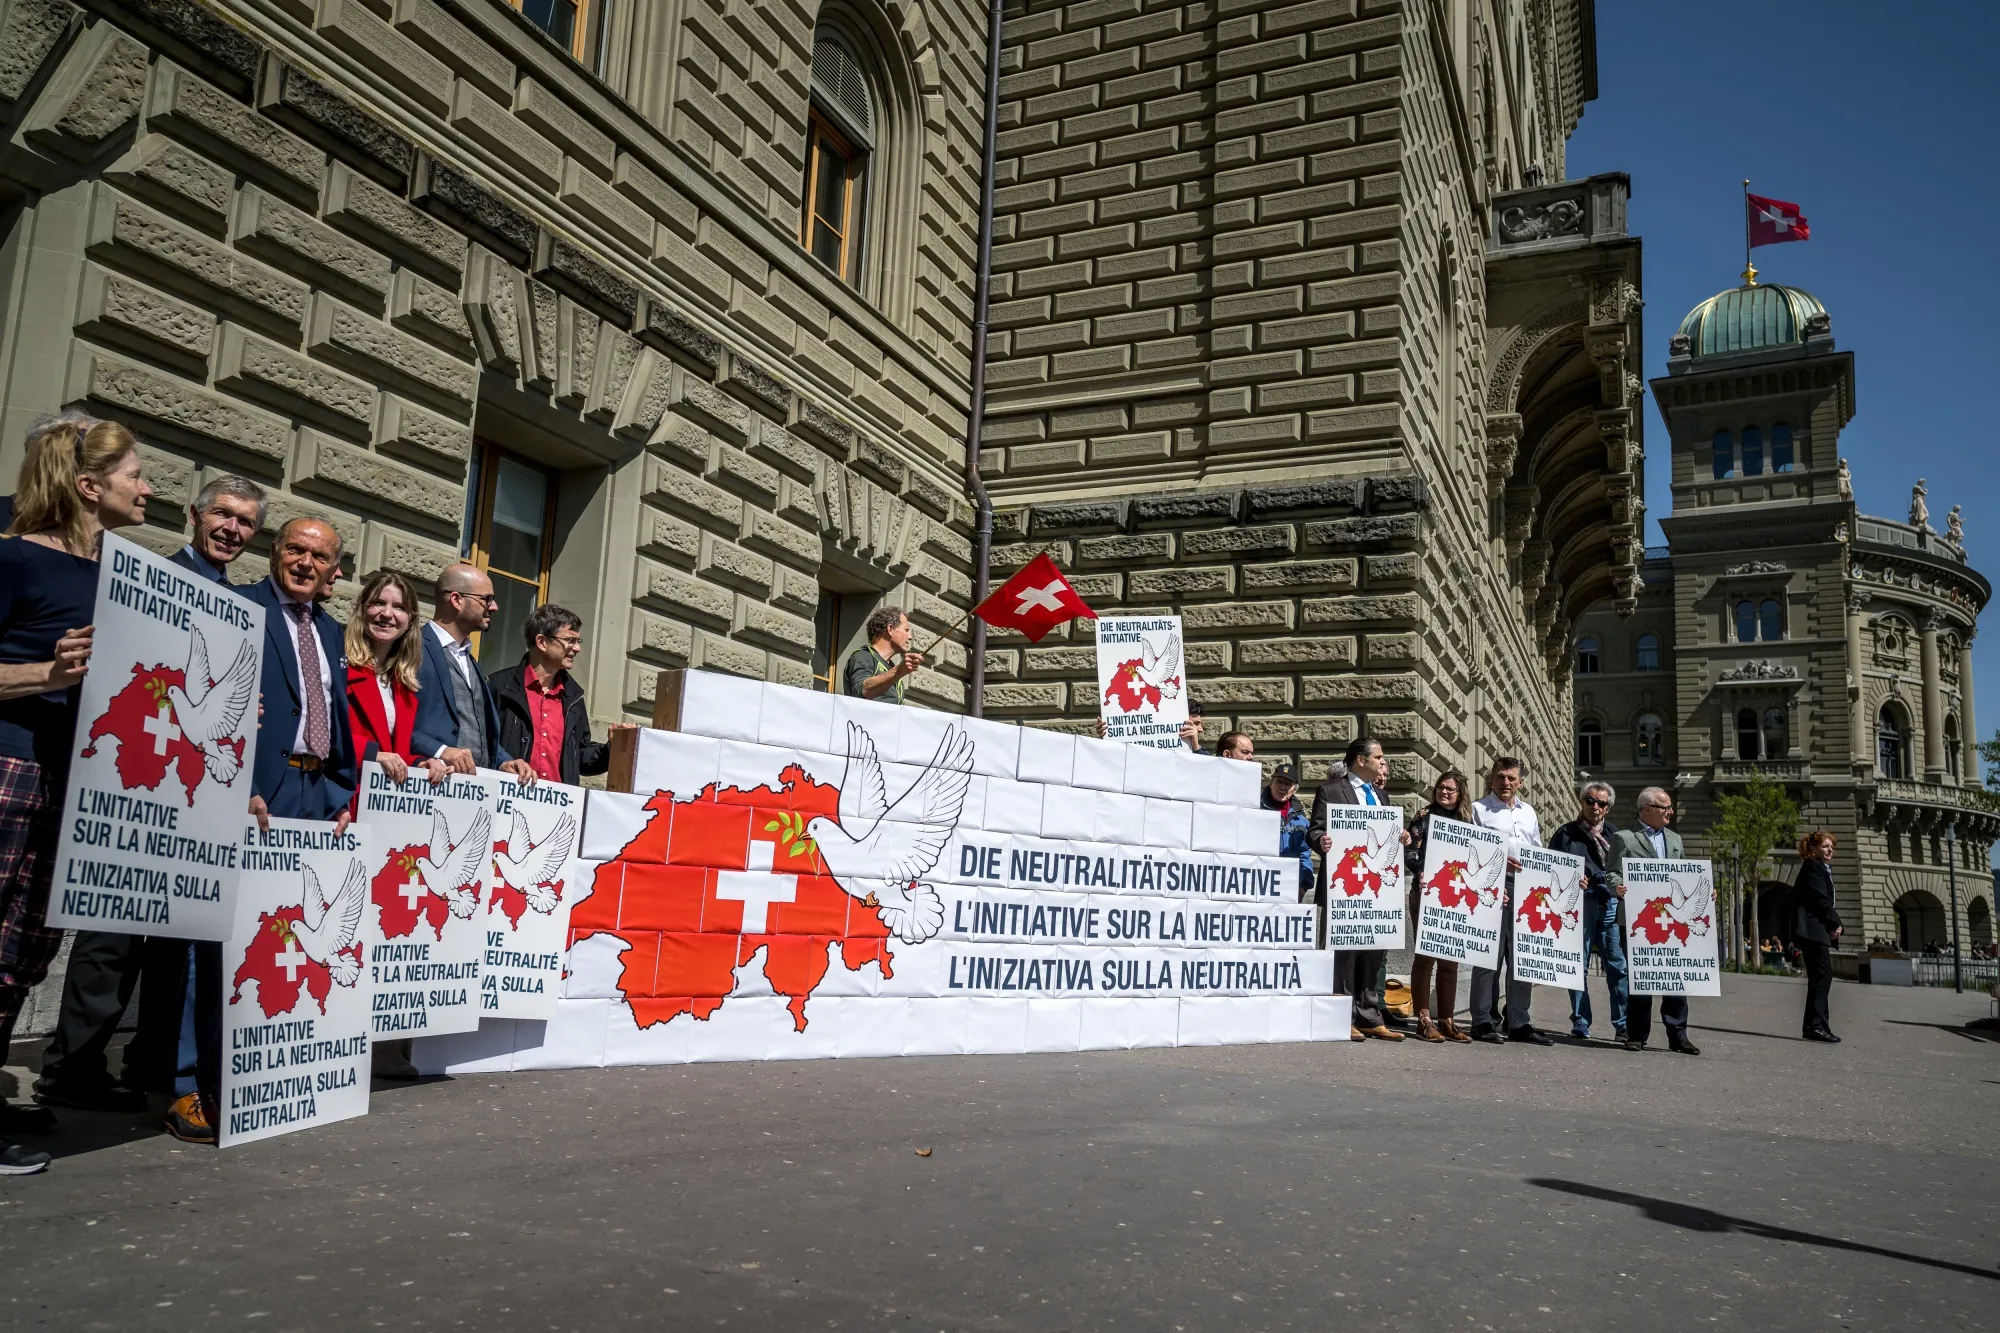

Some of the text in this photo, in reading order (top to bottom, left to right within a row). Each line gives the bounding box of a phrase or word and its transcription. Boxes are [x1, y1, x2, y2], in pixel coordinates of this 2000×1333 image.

[113, 549, 255, 631] DIE NEUTRALITÄTS-
[109, 577, 191, 632] INITIATIVE
[1100, 620, 1175, 632] DIE NEUTRALITÄTS-
[1101, 633, 1141, 643] INITIATIVE
[1107, 714, 1153, 726] L'INITIATIVE
[1108, 723, 1183, 737] SUR LA NEUTRALIT
[1157, 738, 1183, 749] SULLA
[370, 772, 391, 791] DIE
[499, 780, 574, 807] TRALITÄTS-
[78, 787, 179, 830] L'INITIATIVE
[368, 793, 433, 815] INITIATIVE
[1331, 809, 1398, 821] DIE NEUTRALITÄTS-
[1331, 820, 1367, 830] INITIATIVE
[1433, 820, 1503, 845] DIE NEUTRALITÄTS-
[73, 818, 237, 869] SUR LA NEUTRALITÉ
[259, 828, 361, 851] NEUTRALITÄTS-
[1432, 831, 1470, 847] INITIATIVE
[242, 850, 300, 871] NITIATIVE
[1520, 849, 1579, 868] DIE NEUTRALITÄTS-
[1627, 862, 1705, 874] DIE NEUTRALITÄTS-
[67, 858, 220, 902] L'INIZIATIVA SULLA
[959, 844, 1281, 897] DIE NEUTRALITÄTSINITIATIVE
[1628, 873, 1670, 883] INITIATIVE
[61, 889, 169, 924] NEUTRALITÀ
[1331, 899, 1373, 909] L'INITIATIVE
[954, 899, 1312, 943] L'INITIATIVE SUR LA NEUTRALITÉ
[1331, 908, 1402, 920] SUR LA NEUTRALITÉ
[1424, 905, 1467, 923] L'INITIATIVE
[1331, 924, 1397, 935] L'INIZIATIVA SULLA
[1423, 917, 1497, 941] SUR LA NEUTRALITÉ
[1330, 933, 1375, 945] NEUTRALITÀ
[1421, 930, 1490, 953] L'INIZIATIVA SULLA
[1517, 933, 1554, 947] L'INITIATIVE
[372, 944, 430, 962] NITIATIVE
[1420, 941, 1465, 959] NEUTRALITÀ
[1517, 943, 1581, 962] SUR LA NEUTRALITÉ
[1632, 947, 1680, 956] L'INITIATIVE
[484, 949, 559, 971] EUTRALITÉ
[1517, 957, 1576, 976] L'INIZIATIVA SULLA
[1633, 957, 1715, 968] SUR LA NEUTRALITÉ
[384, 967, 400, 983] LA
[405, 959, 479, 982] NEUTRALITÉ
[949, 955, 1301, 991] L'INIZIATIVA SULLA NEUTRALITÀ
[1517, 969, 1557, 983] NEUTRALITÀ
[1634, 971, 1710, 981] L'INIZIATIVA SULLA
[501, 975, 544, 994] SULLA
[1634, 979, 1685, 992] NEUTRALITÀ
[372, 991, 425, 1011] IZIATIVA
[429, 989, 467, 1007] SULLA
[372, 1009, 427, 1032] TRALITÀ
[233, 1019, 314, 1049] L'INITIATIVE
[232, 1032, 367, 1075] SUR LA NEUTRALITÉ
[231, 1067, 356, 1109] L'INIZIATIVA SULLA
[230, 1094, 316, 1135] NEUTRALITÀ
